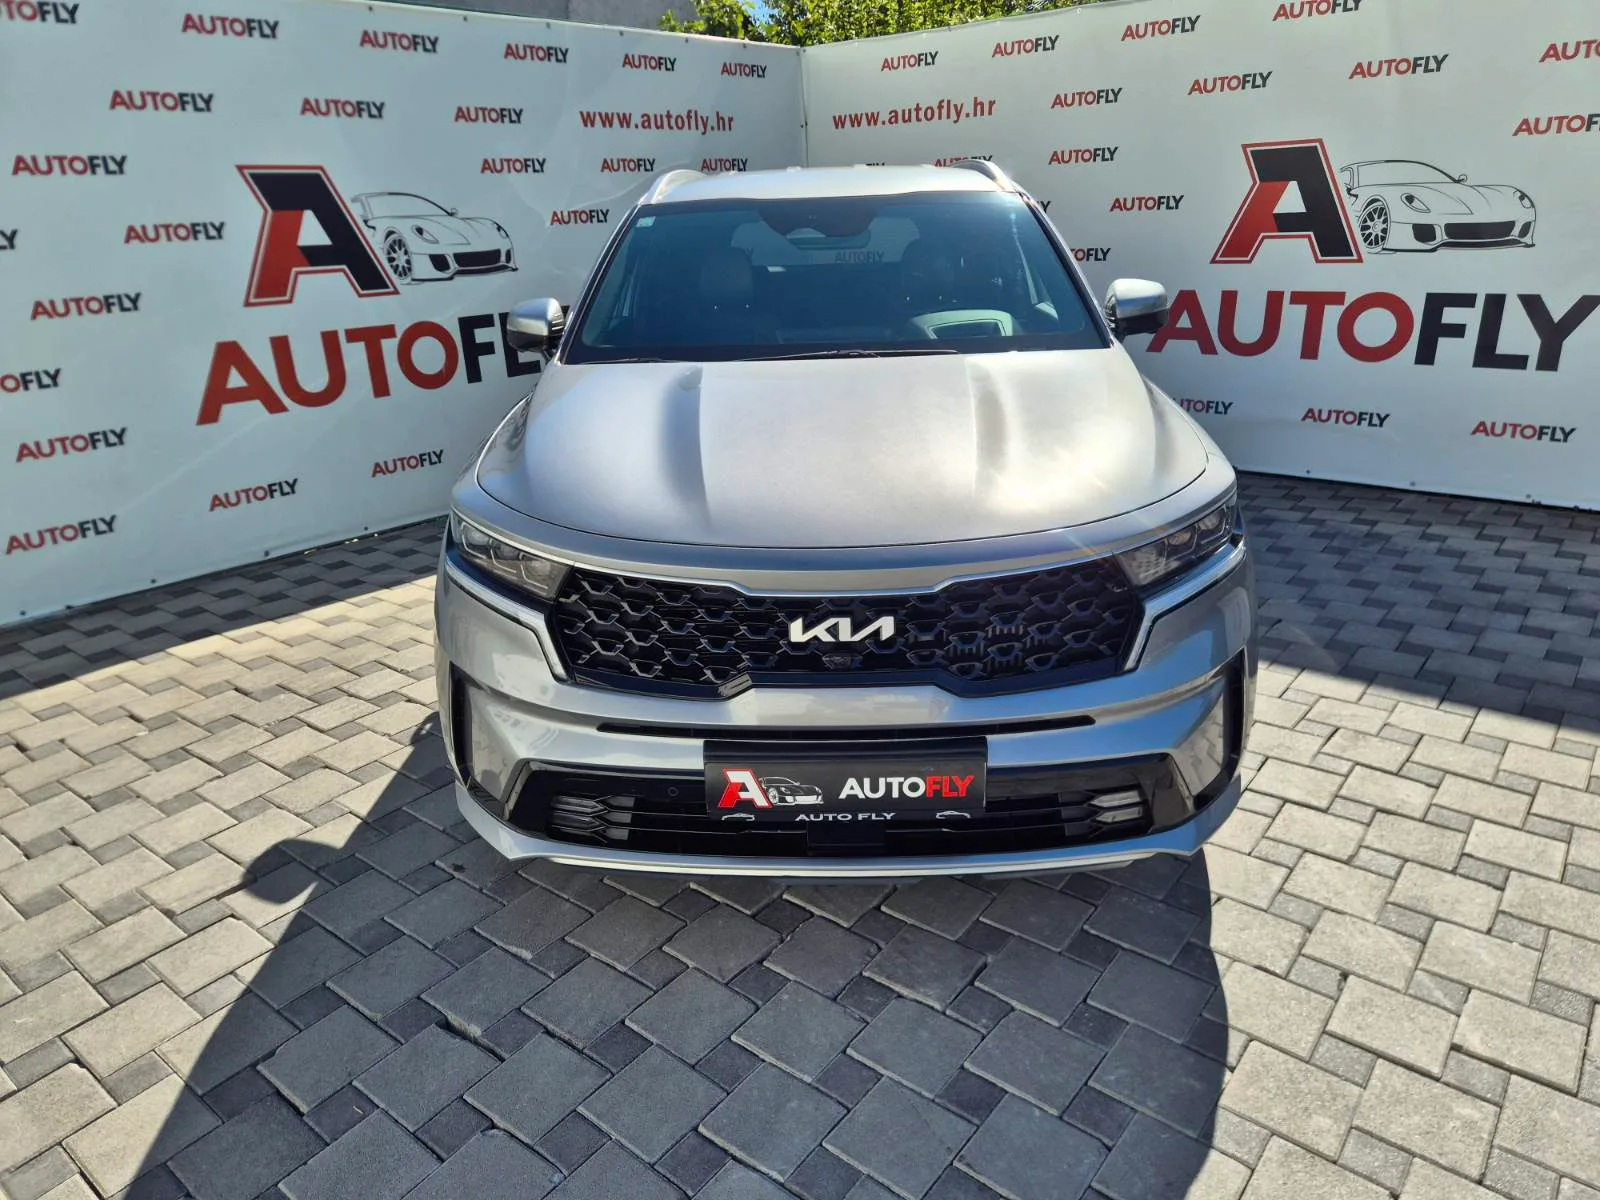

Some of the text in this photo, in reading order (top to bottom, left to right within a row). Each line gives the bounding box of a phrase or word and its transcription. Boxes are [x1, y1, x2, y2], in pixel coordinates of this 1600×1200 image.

[0, 0, 79, 24] TOFLY
[1273, 0, 1361, 21] AUTOFLY
[182, 14, 279, 39] AUTOFLY
[1121, 15, 1200, 41] AUTOFLY
[360, 30, 438, 53] AUTOFLY
[992, 35, 1059, 57] AUTOFLY
[1540, 40, 1600, 62] AUT
[504, 44, 568, 63] AUTOFLY
[623, 54, 676, 71] AUTOFLY
[881, 51, 938, 71] AUTOFLY
[721, 63, 767, 78] AUTOFLY
[1349, 54, 1448, 79] AUTOFLY
[1188, 71, 1272, 95] AUTOFLY
[110, 90, 213, 112] AUTOFLY
[301, 98, 384, 119] AUTOFLY
[1051, 88, 1122, 108] AUTOFLY
[455, 107, 523, 124] AUTOFLY
[580, 110, 733, 135] www.autofly.hr
[833, 97, 995, 129] www.autofly.hr
[1513, 114, 1600, 136] AUTOF
[13, 155, 126, 175] AUTOFLY
[481, 158, 546, 173] AUTOFLY
[601, 158, 655, 172] AUTOFLY
[701, 159, 747, 172] AUTOFLY
[1048, 147, 1118, 165] AUTOFLY
[1110, 195, 1184, 212] AUTOFLY
[551, 209, 609, 225] AUTOFLY
[124, 222, 224, 244] AUTOFLY
[31, 293, 141, 320] AUTOFLY
[1146, 289, 1600, 372] AUTOFLY
[196, 305, 570, 426] AUTOFL
[1173, 398, 1234, 415] TOFLY
[1301, 408, 1389, 427] AUTOFLY
[1471, 421, 1576, 442] AUTOFLY
[16, 428, 126, 462] AUTOFLY
[372, 449, 443, 477] AUTOFLY
[210, 478, 298, 511] AUTOFLY
[6, 515, 116, 555] AUTOFLY
[789, 616, 894, 642] KIA
[839, 775, 974, 799] AUTOFLY
[794, 812, 896, 822] AUTO FLY
